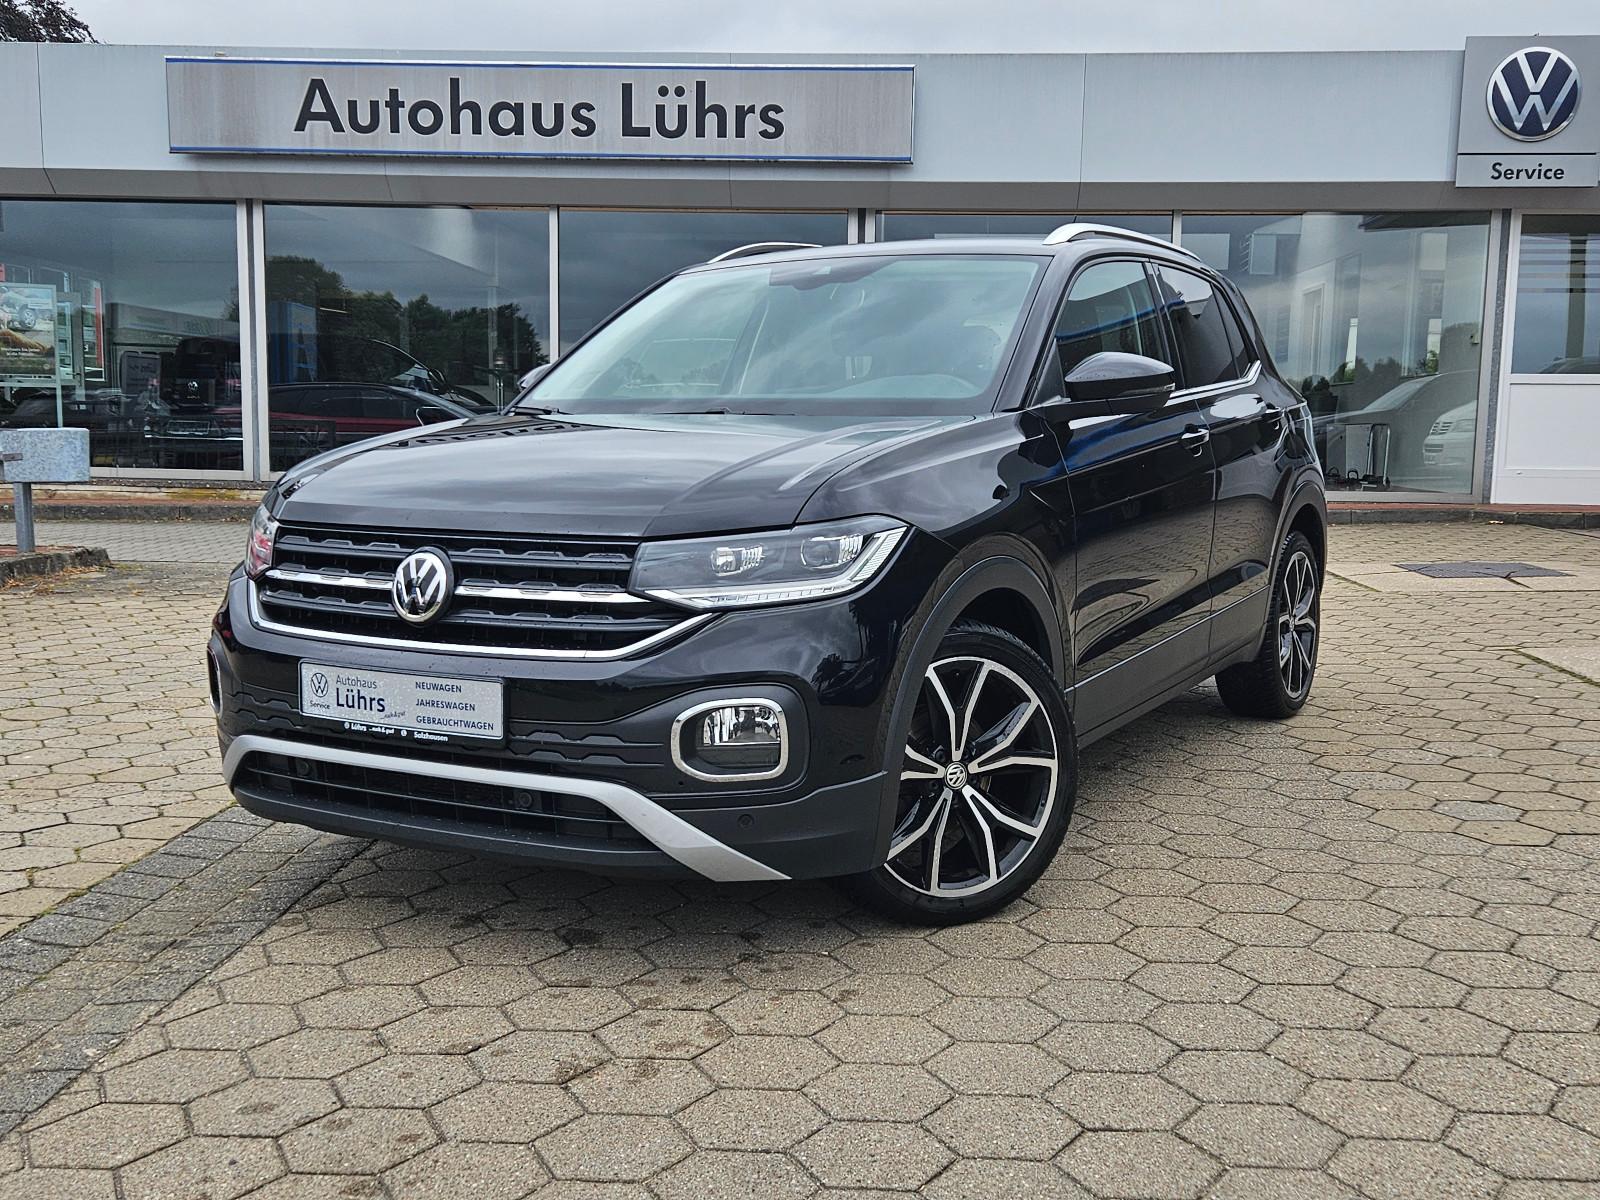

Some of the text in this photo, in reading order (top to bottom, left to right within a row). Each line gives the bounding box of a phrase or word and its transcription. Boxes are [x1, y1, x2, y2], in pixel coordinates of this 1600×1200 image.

[294, 77, 785, 140] Autohaus Lührs
[1491, 162, 1565, 180] Service
[336, 675, 378, 689] Autohaus
[415, 681, 462, 693] NEUWAGEN
[309, 700, 331, 710] Service
[336, 687, 386, 712] Lührs
[415, 698, 475, 711] JAHRESWAGEN
[416, 715, 494, 731] GEBRAUCHTWAGEN
